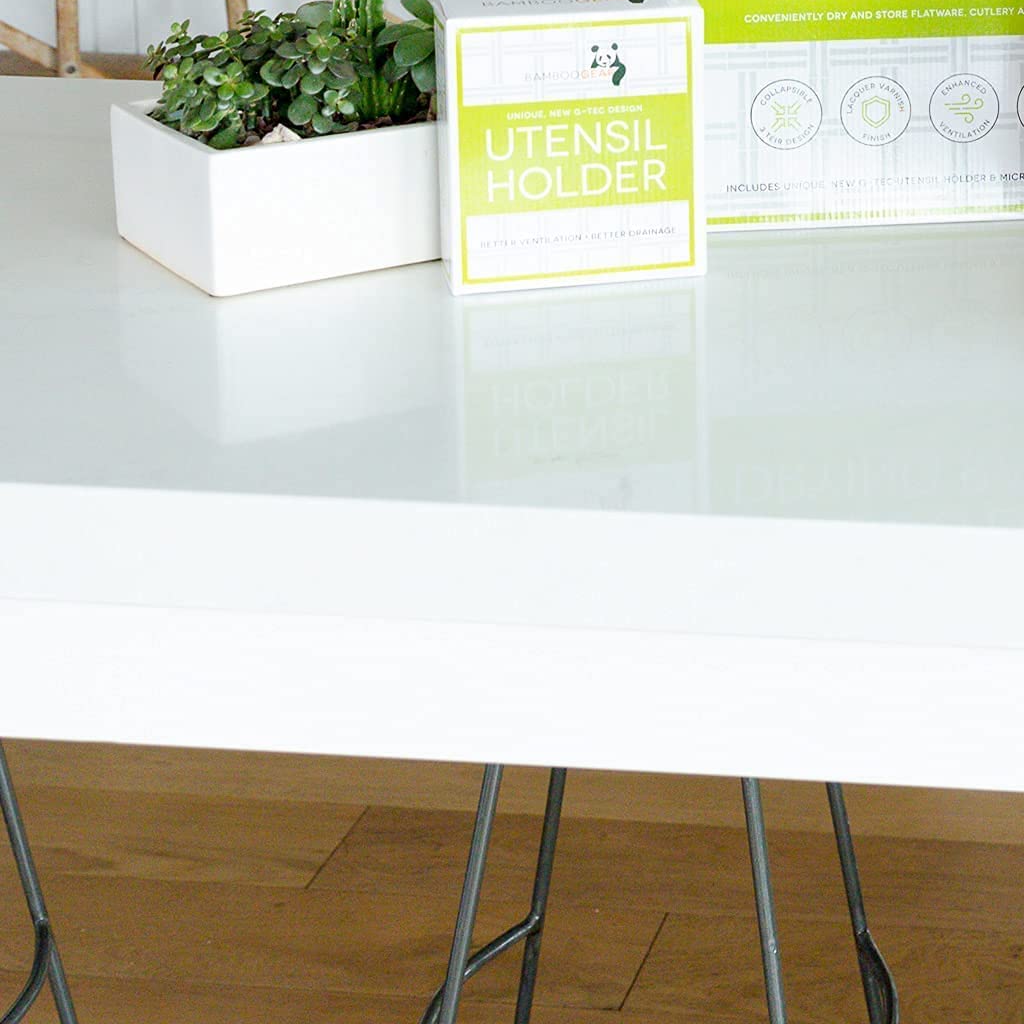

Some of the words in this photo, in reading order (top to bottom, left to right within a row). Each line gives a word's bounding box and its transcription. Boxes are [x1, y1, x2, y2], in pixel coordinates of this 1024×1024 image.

[744, 11, 823, 23] CONVENIENTLY
[827, 11, 847, 21] DRY
[850, 10, 872, 20] AND
[875, 9, 908, 19] STORE
[969, 7, 1014, 17] CUTLERY
[760, 85, 813, 106] COLLAPSIBLE
[941, 79, 987, 96] ENHANCED
[847, 83, 876, 115] LACQUER
[879, 82, 905, 113] VARNISH
[550, 108, 571, 118] NEW
[608, 104, 643, 114] DESIGN
[786, 124, 815, 146] DESIGN
[861, 132, 891, 142] FINISH
[939, 119, 991, 139] VENTILATION
[485, 119, 667, 161] UTENSIL
[487, 159, 667, 203] HOLDER
[726, 182, 780, 193] INCLUDES
[944, 174, 986, 184] HOLDER
[629, 226, 676, 237] DRAINAGE
